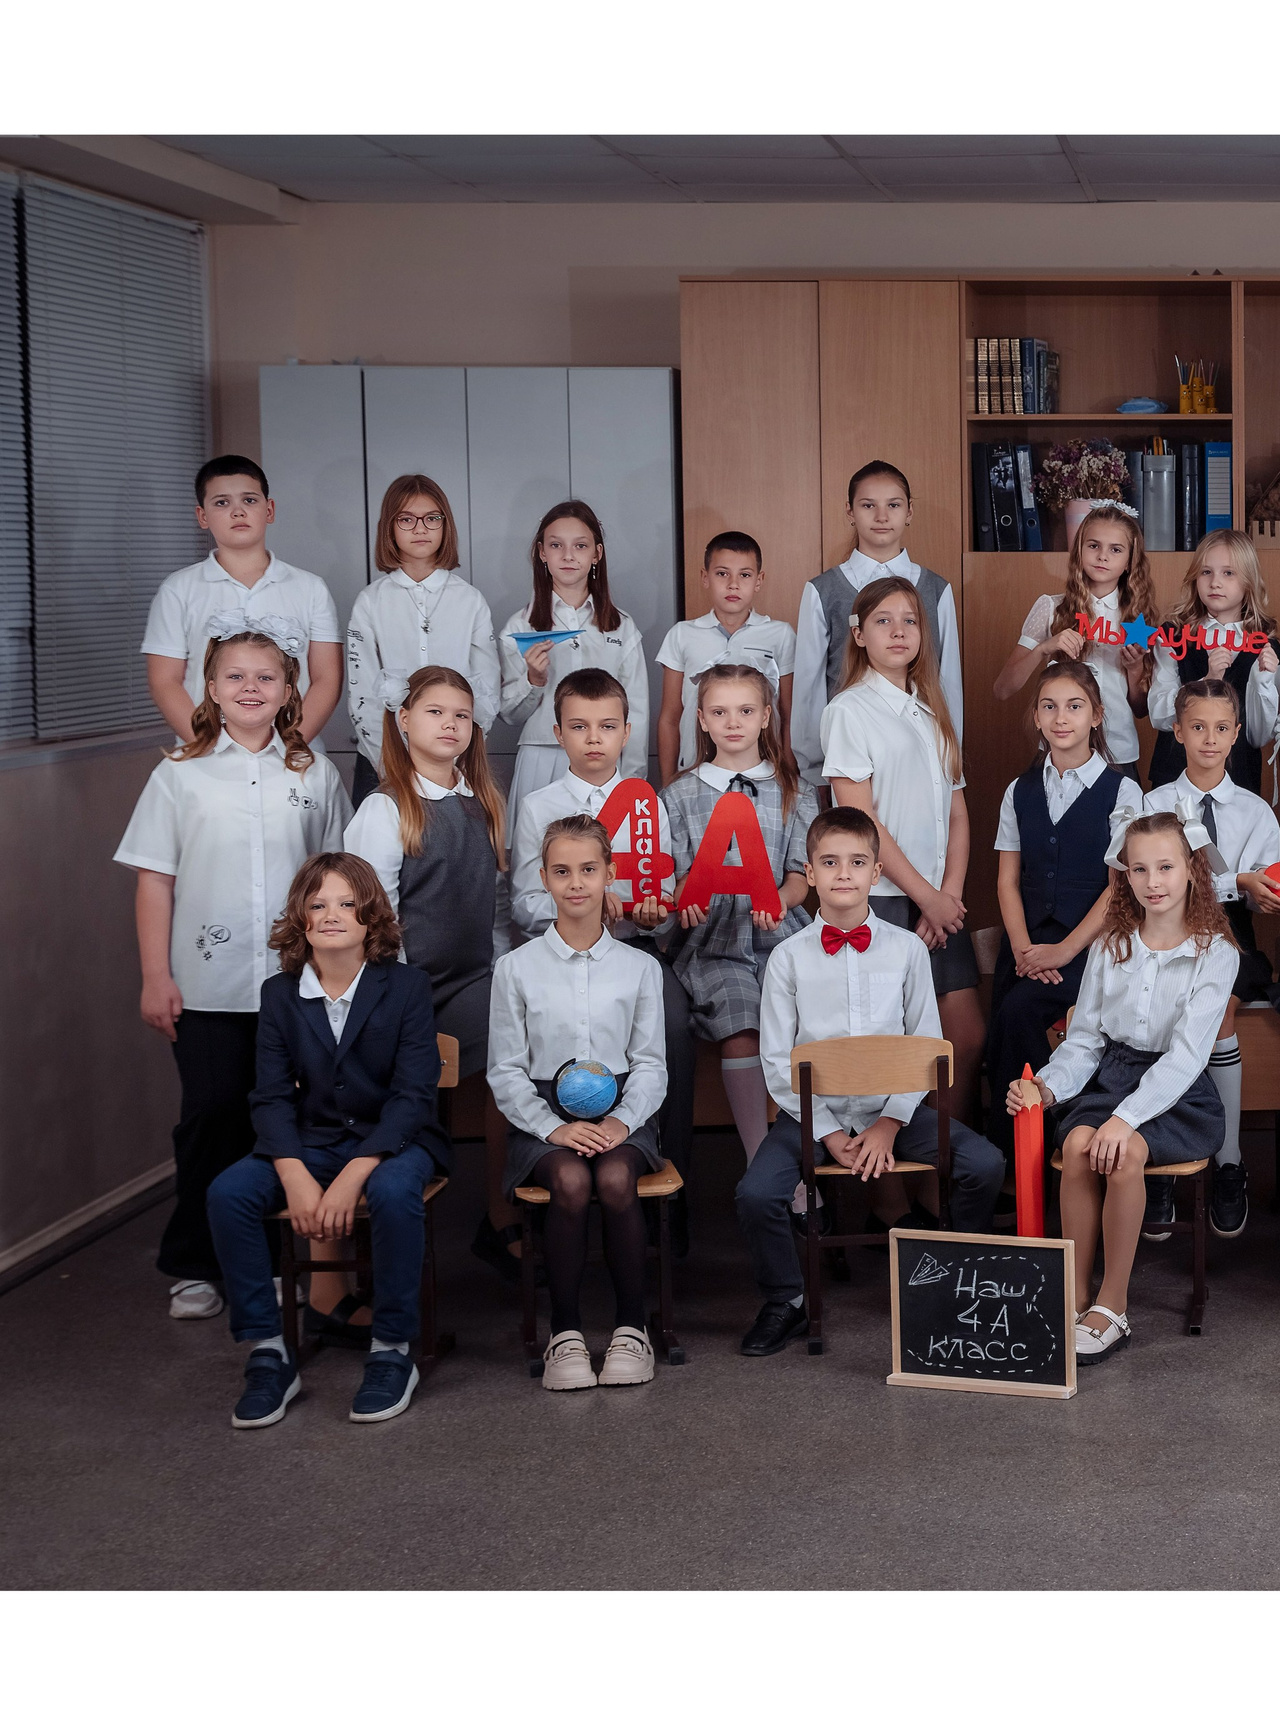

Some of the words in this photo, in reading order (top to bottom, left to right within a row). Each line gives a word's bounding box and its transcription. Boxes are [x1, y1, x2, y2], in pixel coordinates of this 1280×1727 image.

[954, 1267, 1026, 1299] Наш
[956, 1299, 983, 1333] 4
[989, 1303, 1011, 1337] А
